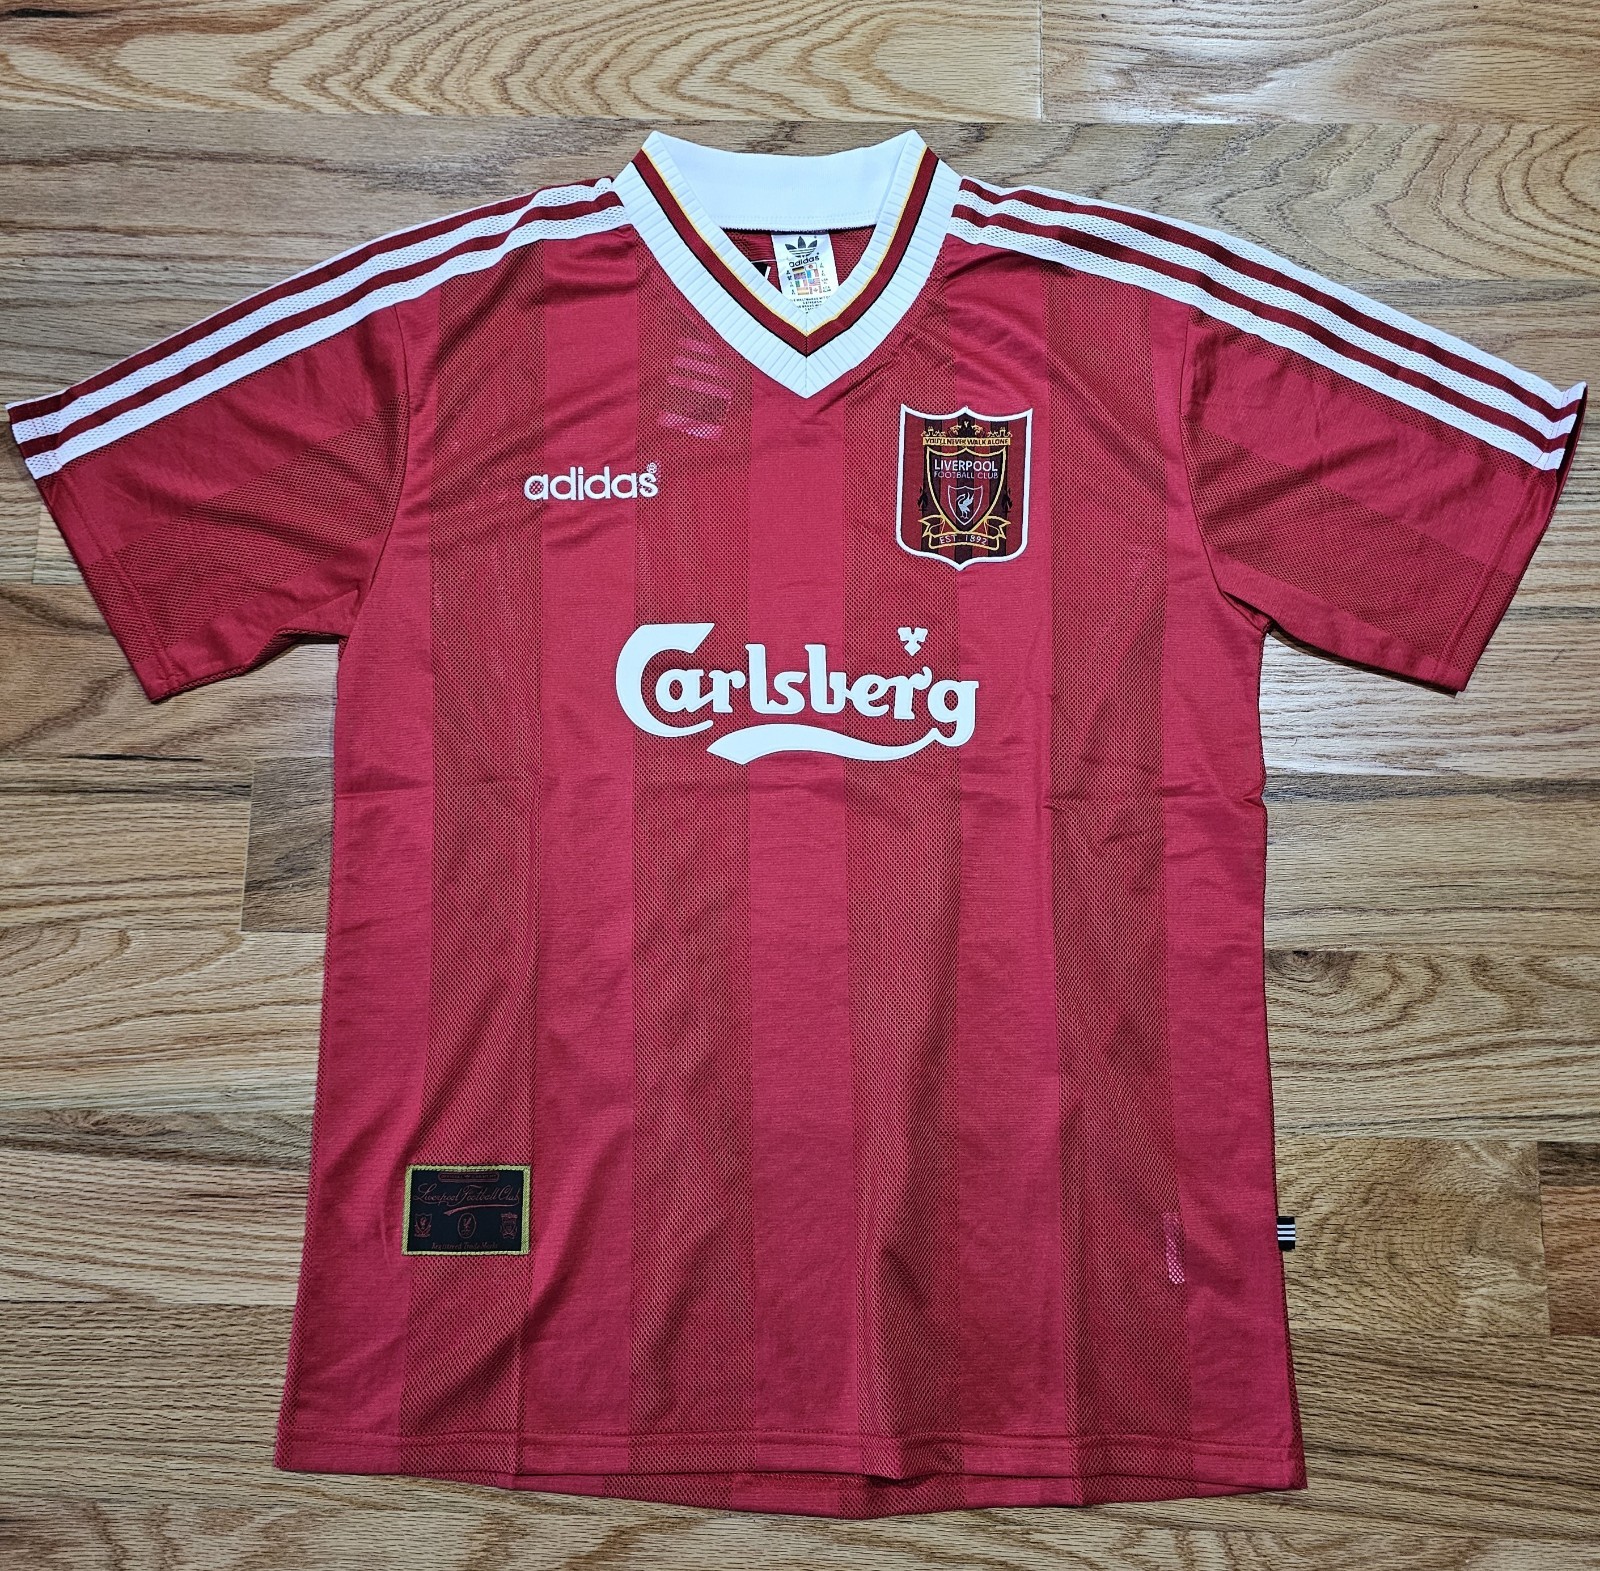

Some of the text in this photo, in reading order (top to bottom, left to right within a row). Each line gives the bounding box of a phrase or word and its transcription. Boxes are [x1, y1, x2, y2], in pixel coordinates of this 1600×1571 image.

[789, 255, 820, 267] adidas
[967, 438, 986, 446] WALK
[934, 459, 998, 471] LIVERPOOL
[524, 466, 658, 500] adidas
[965, 534, 988, 546] 1892
[615, 622, 980, 764] Carlsberg
[413, 1183, 520, 1206] Liverpool Football Club
